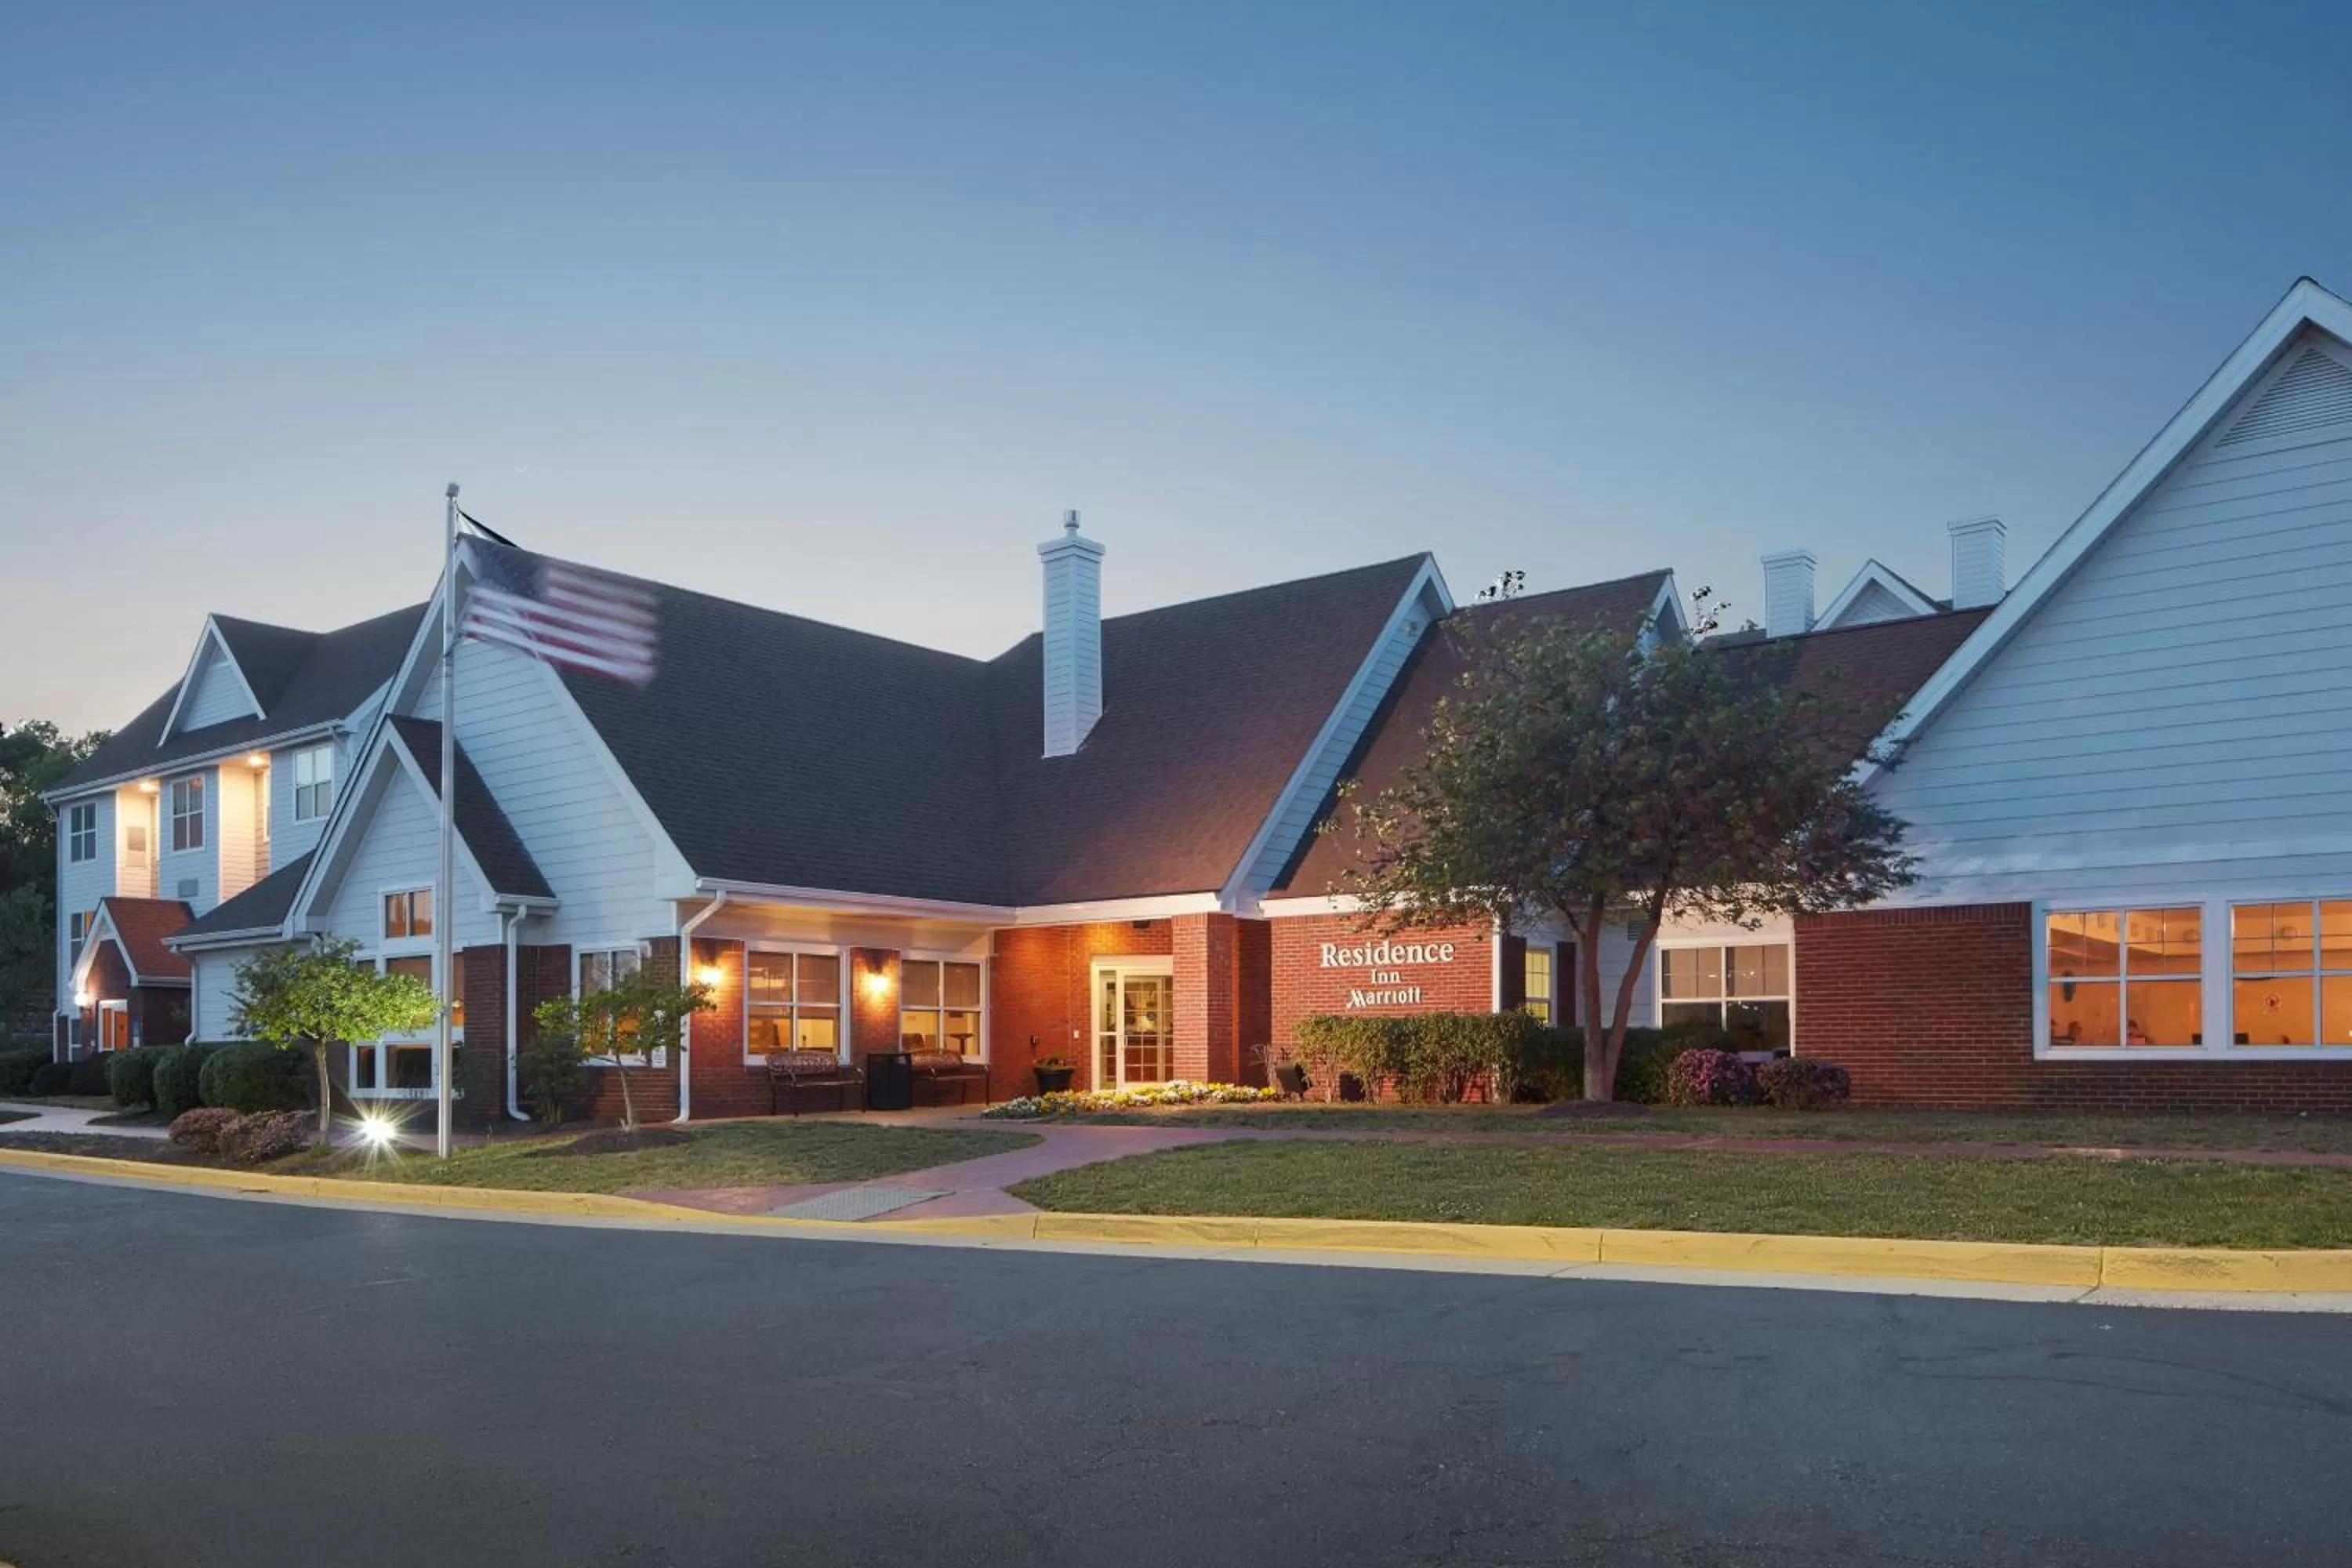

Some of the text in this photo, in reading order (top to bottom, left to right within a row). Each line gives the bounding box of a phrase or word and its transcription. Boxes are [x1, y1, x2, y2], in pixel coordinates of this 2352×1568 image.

[1320, 940, 1455, 967] Residence
[1371, 968, 1401, 984] Inn
[1346, 986, 1421, 1009] Marriott
